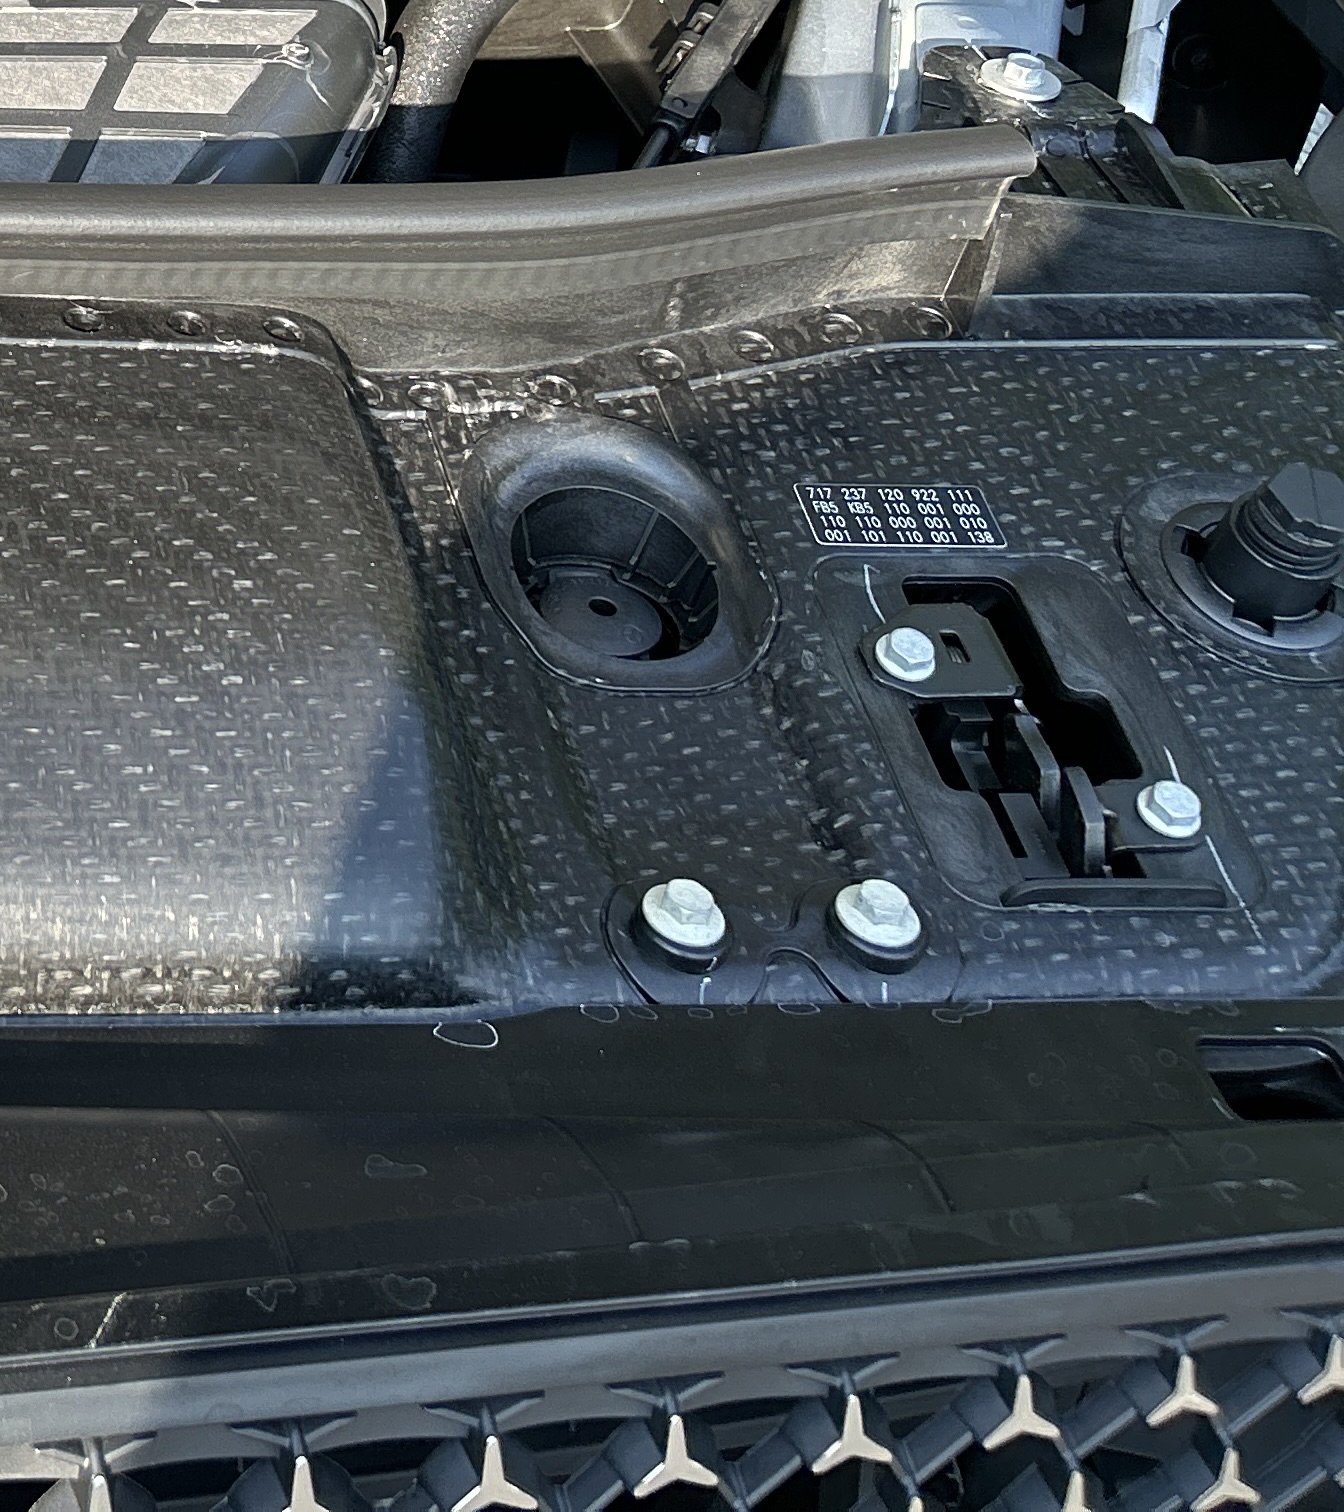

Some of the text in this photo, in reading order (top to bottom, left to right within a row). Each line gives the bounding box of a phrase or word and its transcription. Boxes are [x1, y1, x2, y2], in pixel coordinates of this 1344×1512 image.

[806, 487, 973, 502] 717 237 120 922 111
[813, 501, 980, 515] FB5 KB5 110 001 000
[820, 516, 987, 529] 110 110 000 001 010
[824, 529, 994, 543] 001 101 110 001 138
